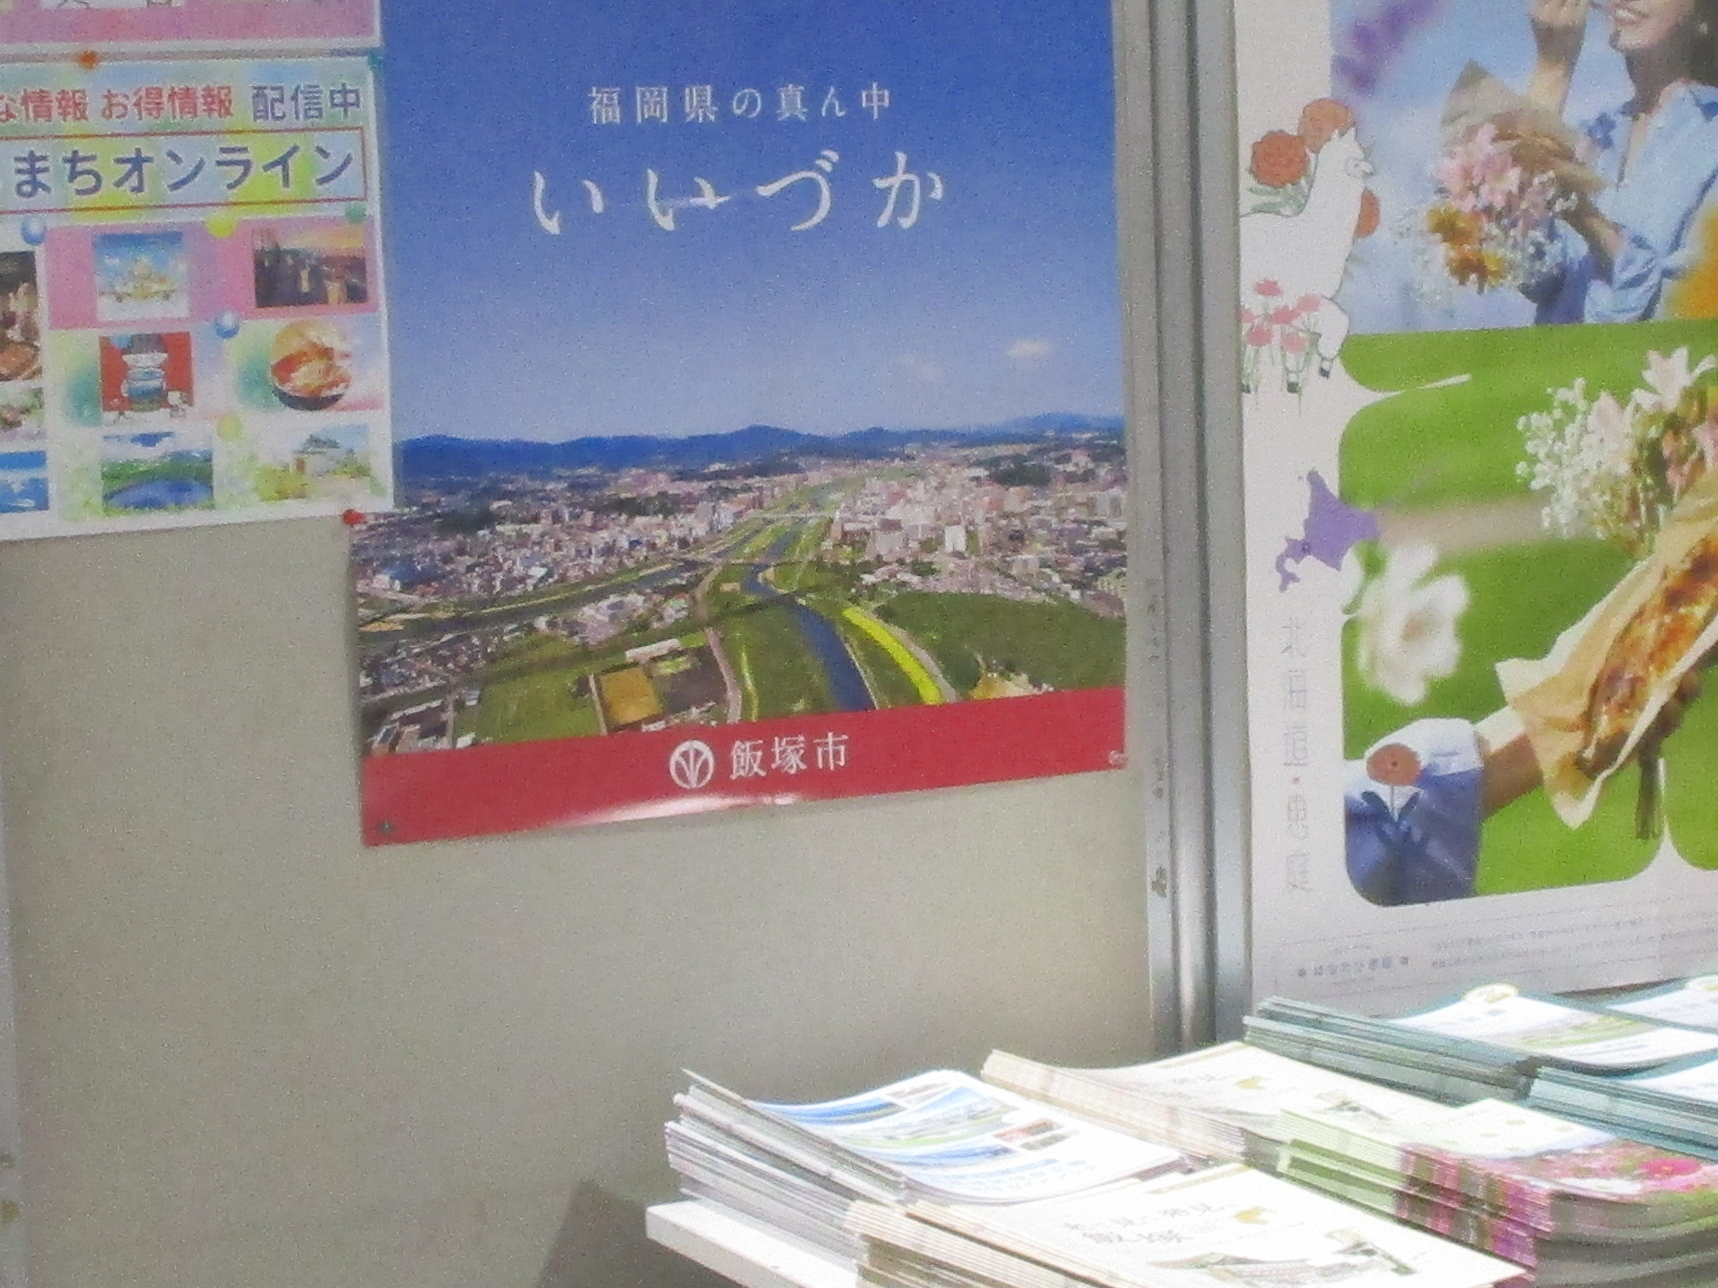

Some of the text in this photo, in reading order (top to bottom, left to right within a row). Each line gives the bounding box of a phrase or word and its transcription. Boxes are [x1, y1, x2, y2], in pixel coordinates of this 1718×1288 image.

[587, 81, 892, 125] 福岡県の真ん中
[532, 149, 945, 235] いいづか
[729, 731, 850, 780] 飯塚市
